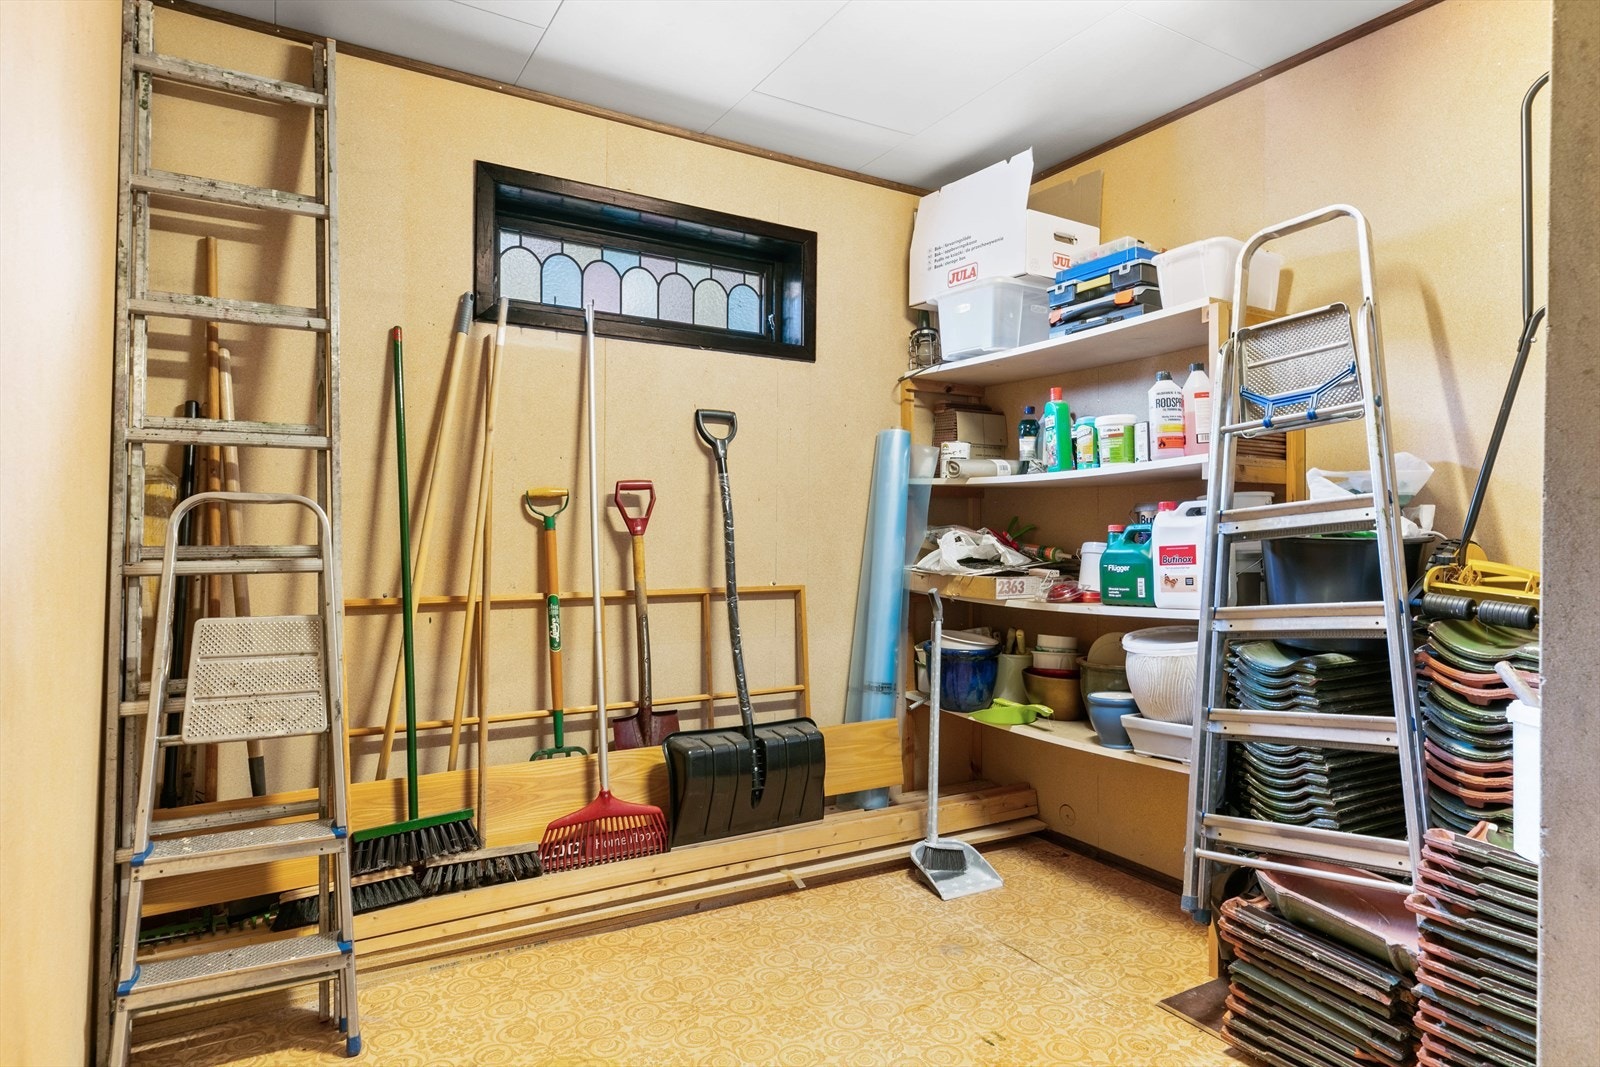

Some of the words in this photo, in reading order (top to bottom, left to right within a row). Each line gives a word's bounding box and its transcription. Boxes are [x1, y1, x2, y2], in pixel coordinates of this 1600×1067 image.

[1053, 256, 1072, 268] JUL
[949, 266, 977, 284] JULA
[1108, 564, 1130, 573] Flügger
[998, 580, 1025, 595] 2363
